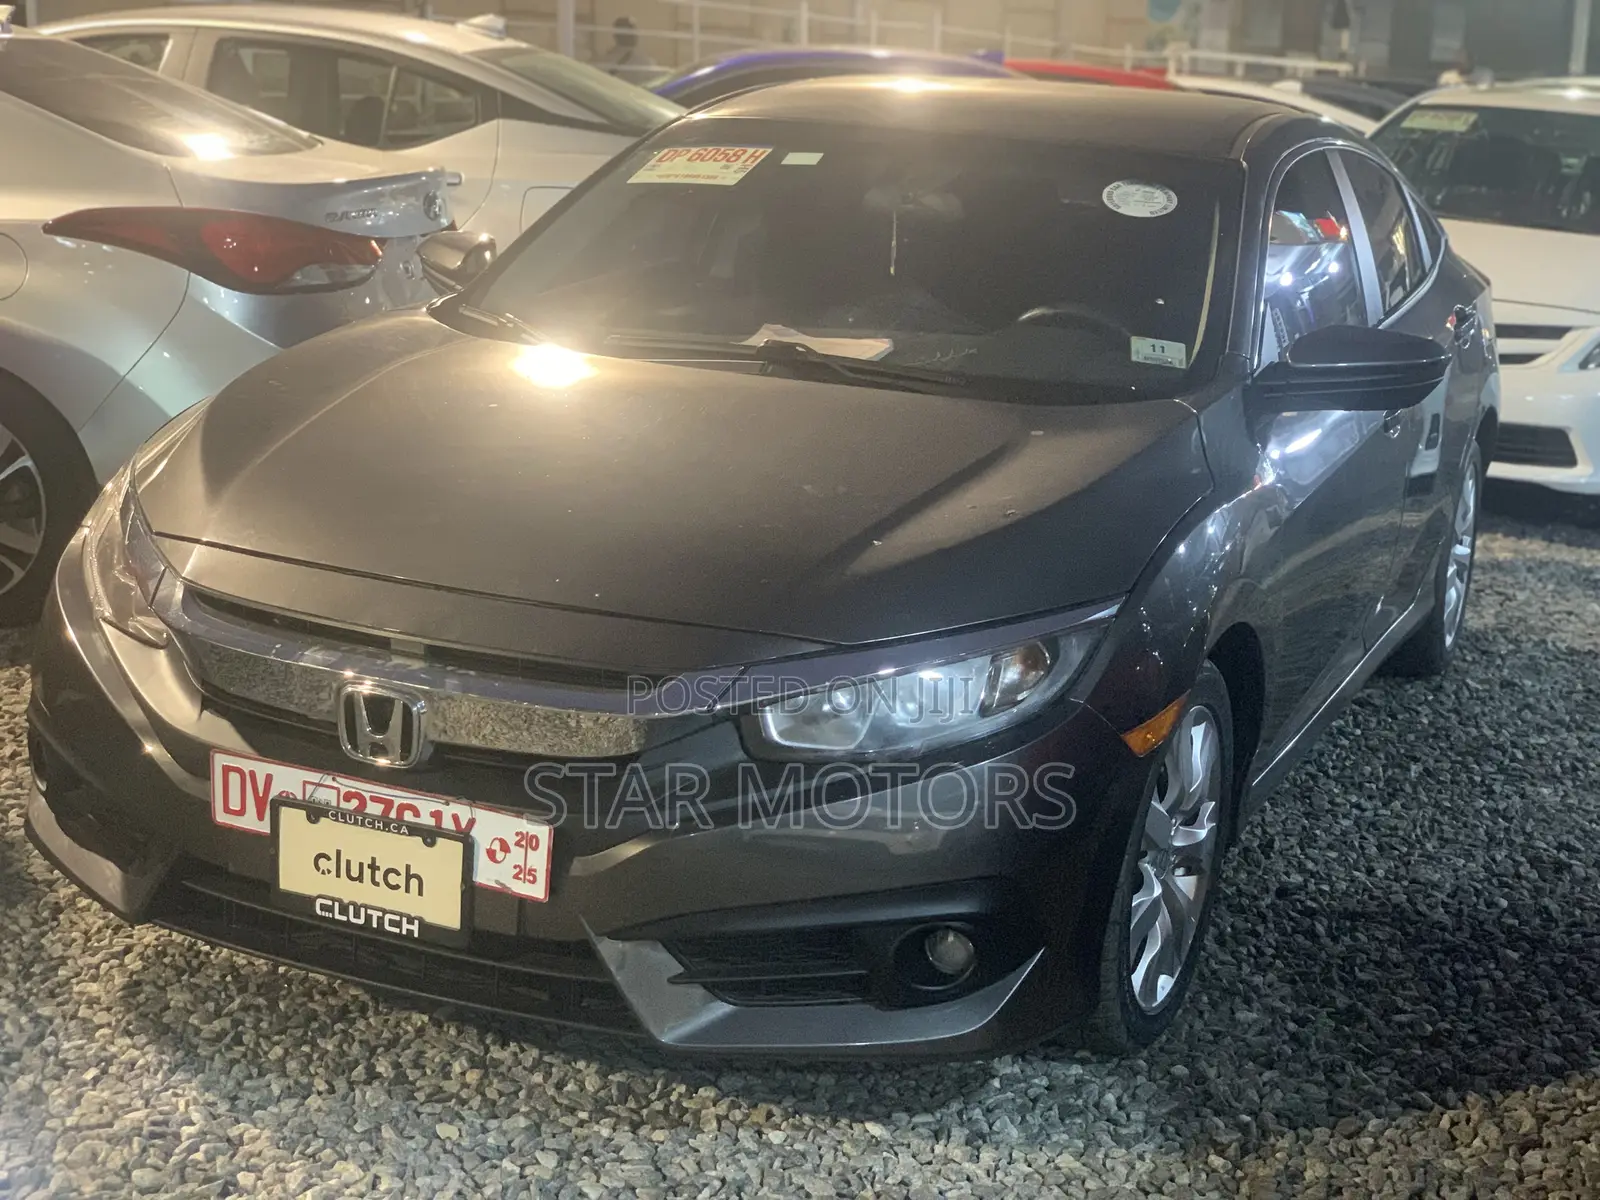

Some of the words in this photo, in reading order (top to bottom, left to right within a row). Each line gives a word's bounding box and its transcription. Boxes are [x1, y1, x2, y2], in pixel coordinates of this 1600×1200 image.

[656, 149, 692, 163] DP
[687, 148, 748, 163] 6058
[743, 149, 767, 164] H
[1150, 343, 1165, 354] 11
[221, 764, 274, 822] DV
[327, 810, 410, 836] CLUTCH.CA
[313, 849, 425, 897] clutch
[315, 898, 420, 938] CLUTCH
